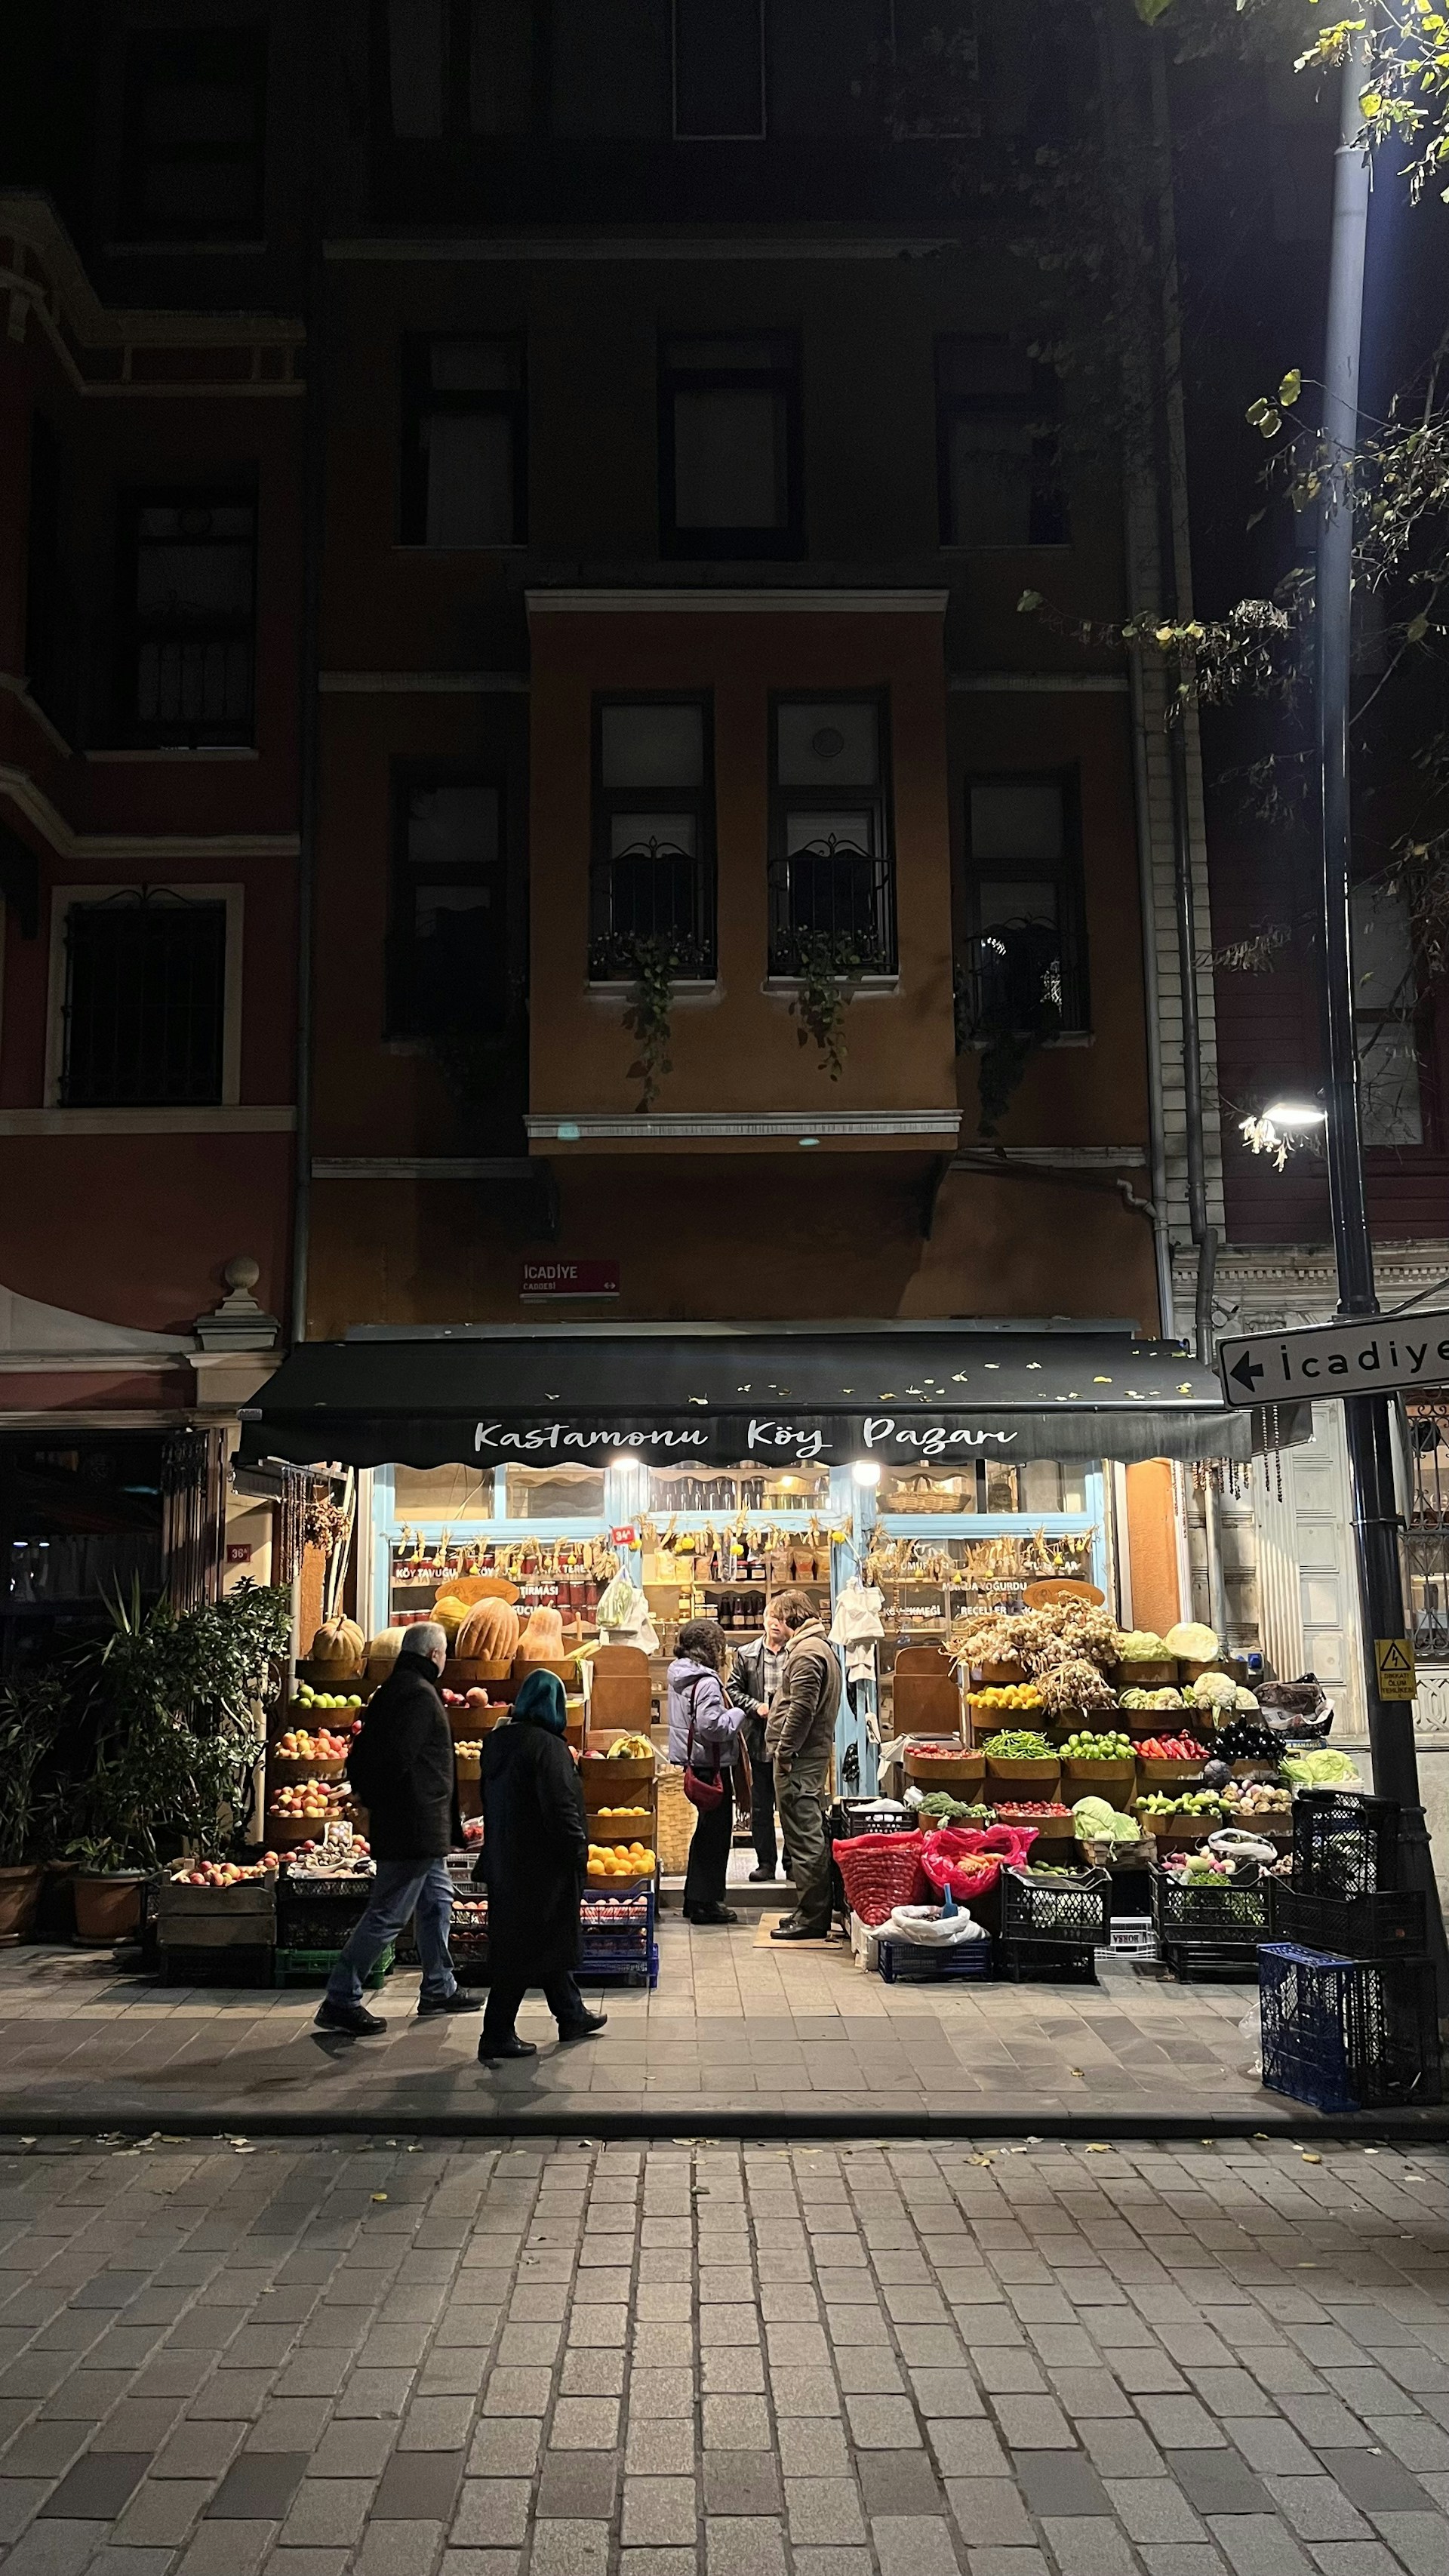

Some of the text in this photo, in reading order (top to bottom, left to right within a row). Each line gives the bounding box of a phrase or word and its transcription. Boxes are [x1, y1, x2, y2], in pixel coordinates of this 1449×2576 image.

[524, 1263, 578, 1279] İCADİYE
[474, 1417, 1018, 1459] Kastamonu Köy Pazarı
[396, 1567, 416, 1578] KÖY
